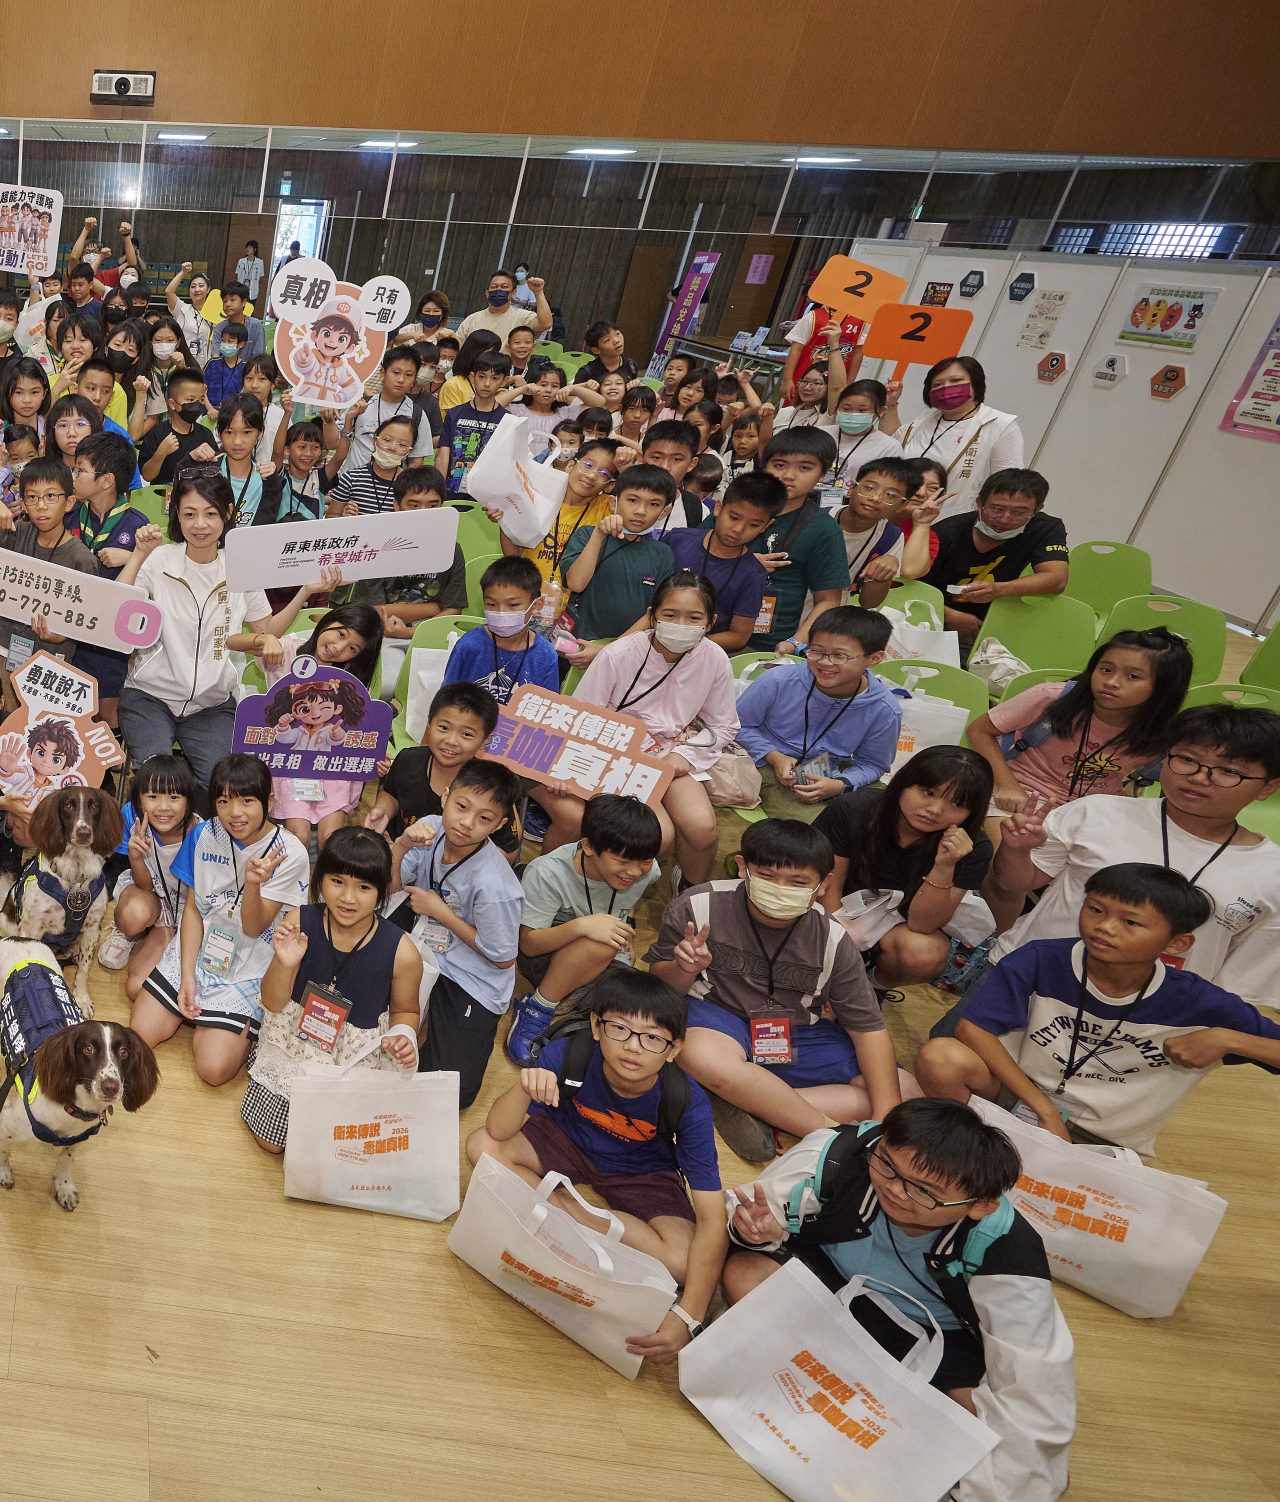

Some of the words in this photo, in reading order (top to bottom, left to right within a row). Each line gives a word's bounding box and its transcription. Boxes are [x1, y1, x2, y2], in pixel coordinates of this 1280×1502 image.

[0, 190, 54, 210] 超能力守護隊
[26, 260, 48, 271] GO!
[279, 274, 332, 310] 真相
[843, 270, 874, 298] 2
[372, 286, 400, 305] 只有
[365, 307, 396, 324] 一個!
[845, 324, 859, 335] 24
[900, 312, 933, 342] 2
[281, 535, 361, 555] 屏東縣政府
[317, 548, 380, 567] 希望城市
[25, 663, 91, 702] 勇敢說不
[514, 692, 636, 753] 衛來傳說
[243, 725, 278, 745] 面對
[343, 729, 380, 749] 誘惑
[84, 726, 122, 766] NO!
[243, 751, 302, 771] 出真相
[312, 754, 376, 774] 做出選擇
[1084, 1071, 1107, 1081] REC.
[1108, 1075, 1127, 1085] DIV.
[391, 1127, 409, 1135] 2026
[1103, 1211, 1131, 1226] 2026
[860, 1415, 888, 1437] 2026
